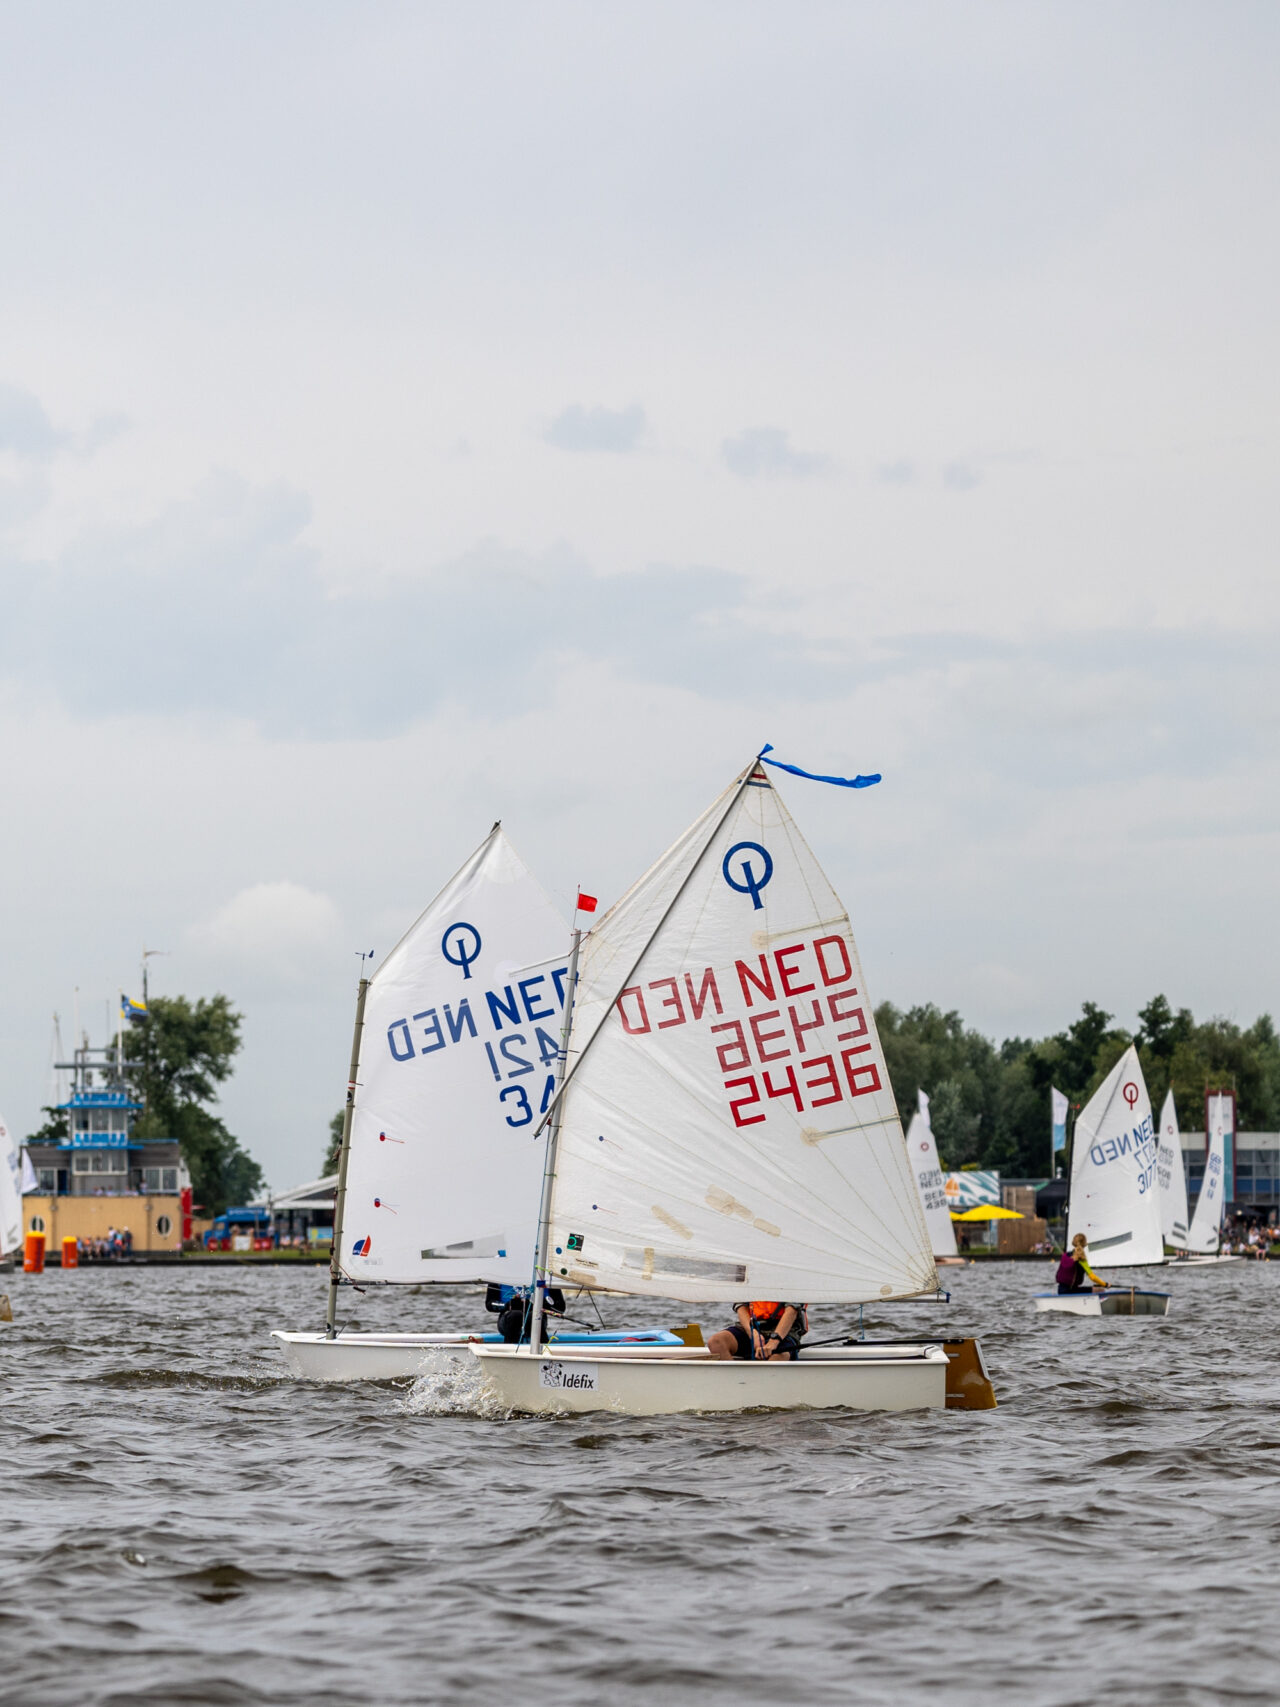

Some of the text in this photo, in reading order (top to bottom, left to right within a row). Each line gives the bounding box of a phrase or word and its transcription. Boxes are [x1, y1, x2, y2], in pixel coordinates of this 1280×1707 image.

[734, 935, 853, 1007] NED
[724, 1043, 882, 1128] 2436
[562, 1373, 594, 1389] Idéfix
